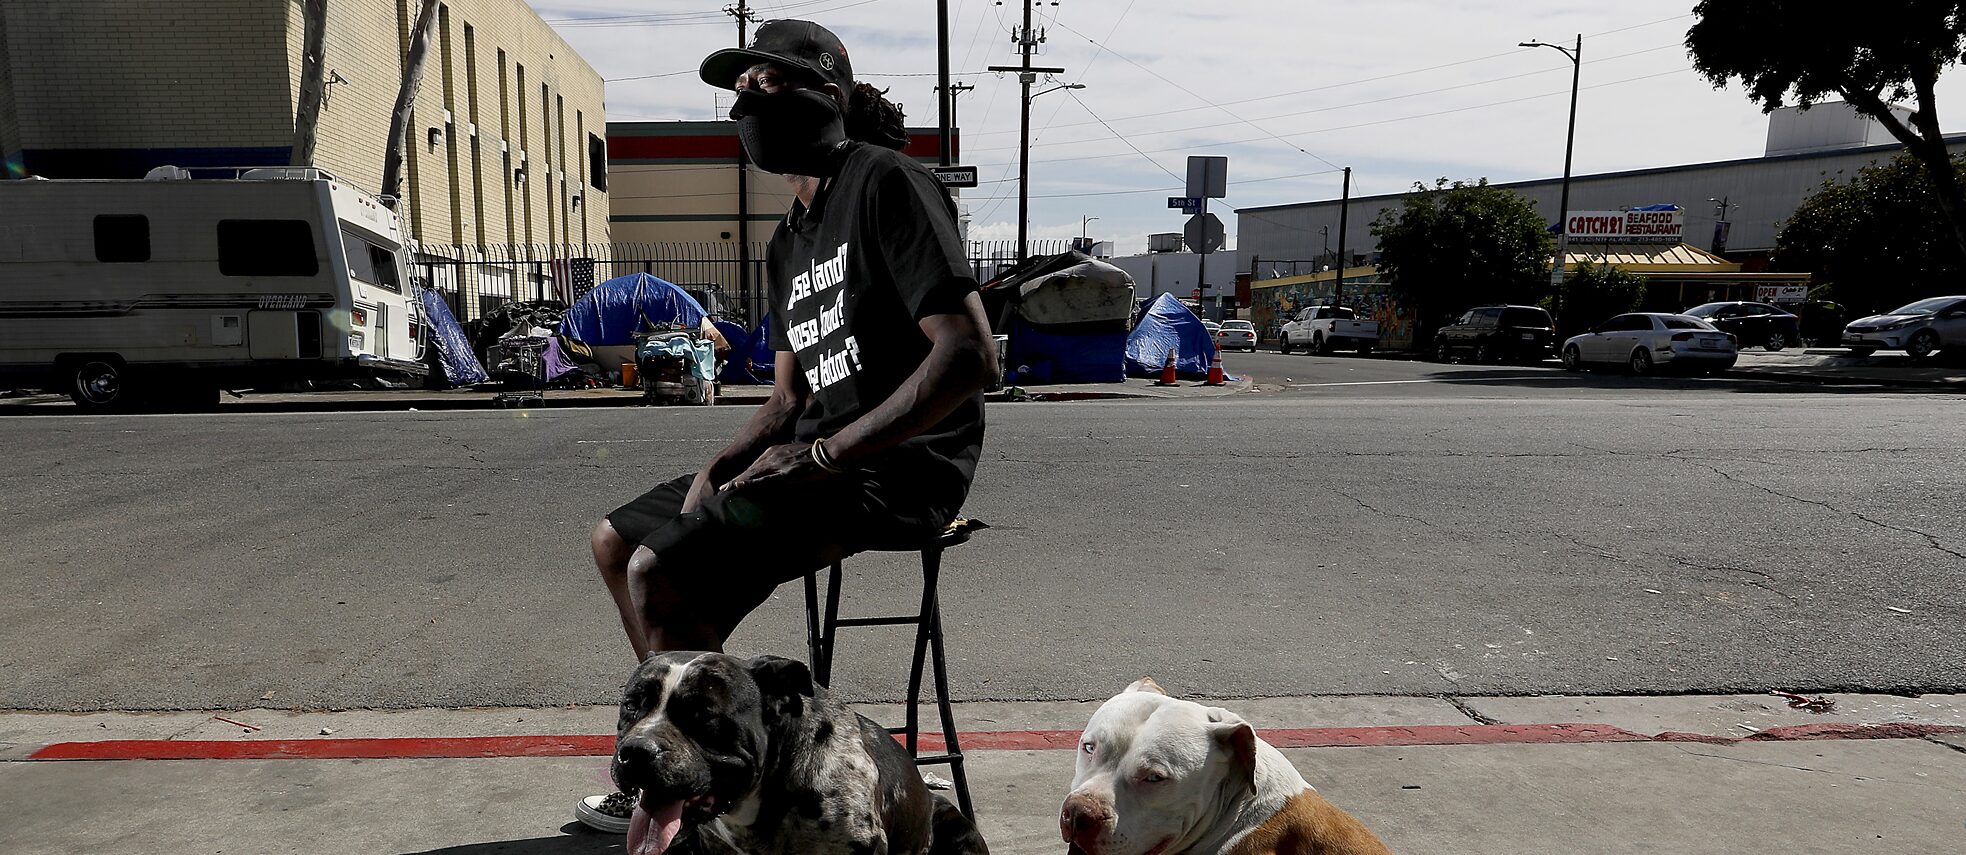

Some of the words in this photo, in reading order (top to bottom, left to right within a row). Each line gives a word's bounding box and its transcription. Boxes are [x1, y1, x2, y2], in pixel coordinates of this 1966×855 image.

[953, 172, 971, 182] WAY
[1172, 198, 1186, 207] 5th
[1187, 198, 1196, 207] St
[1627, 212, 1673, 224] SEAFOOD
[1625, 223, 1682, 235] RESTAURANT
[1758, 287, 1778, 297] OPEN
[258, 295, 308, 309] OVERLAND
[819, 336, 863, 388] labor?
